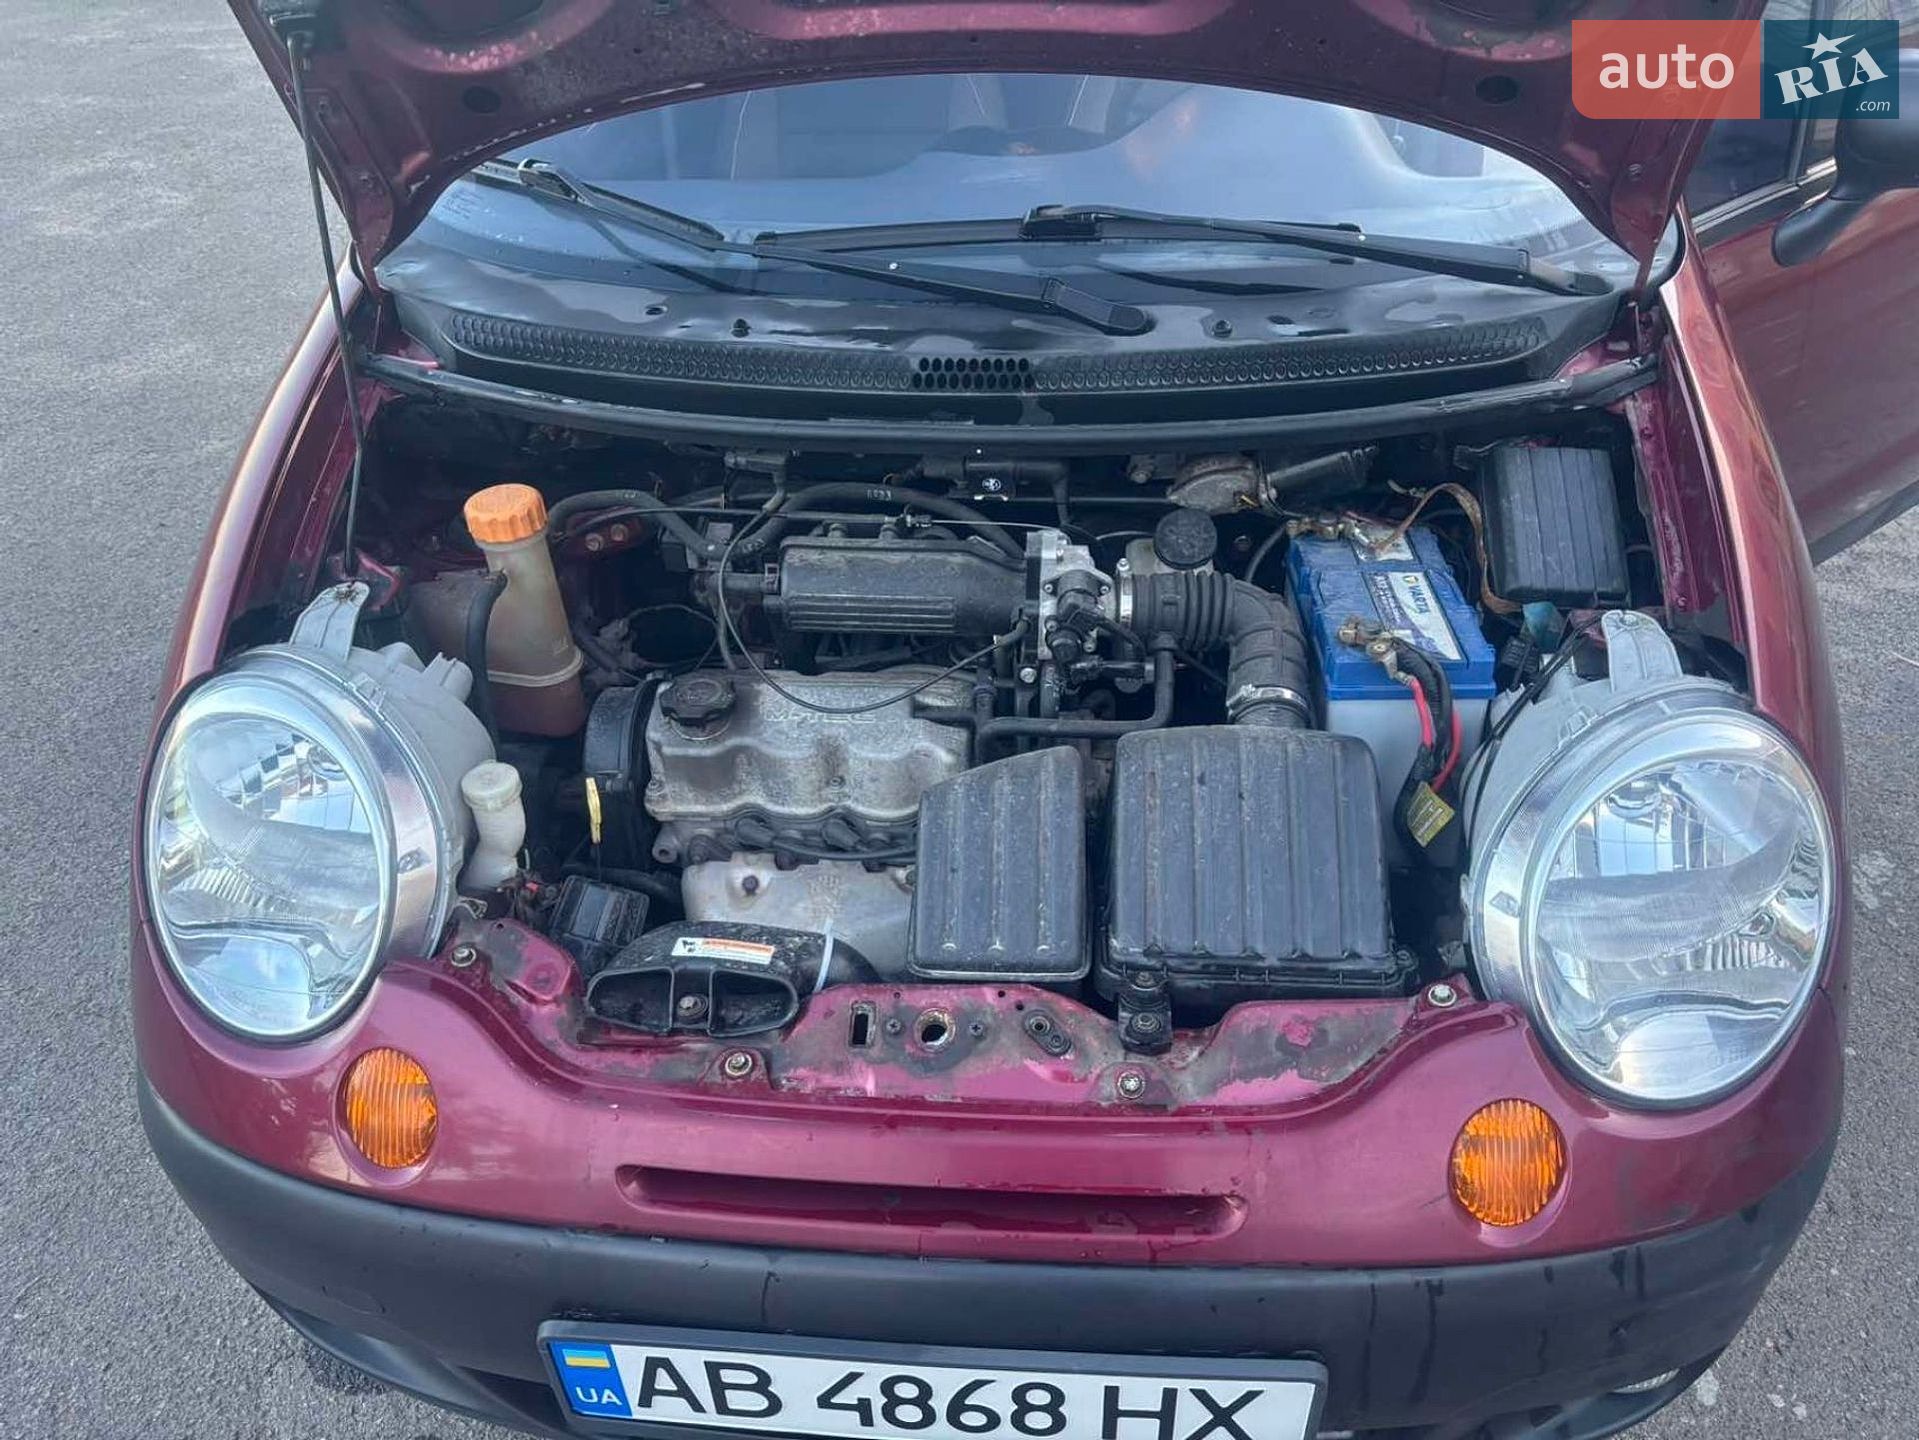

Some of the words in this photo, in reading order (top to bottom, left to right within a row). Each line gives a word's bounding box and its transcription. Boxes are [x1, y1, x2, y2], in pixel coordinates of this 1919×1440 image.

[1408, 585, 1430, 613] VARTA
[576, 1386, 623, 1407] UA
[637, 1356, 783, 1419] AB
[815, 1371, 1067, 1437] 4868
[1101, 1385, 1266, 1440] HX
